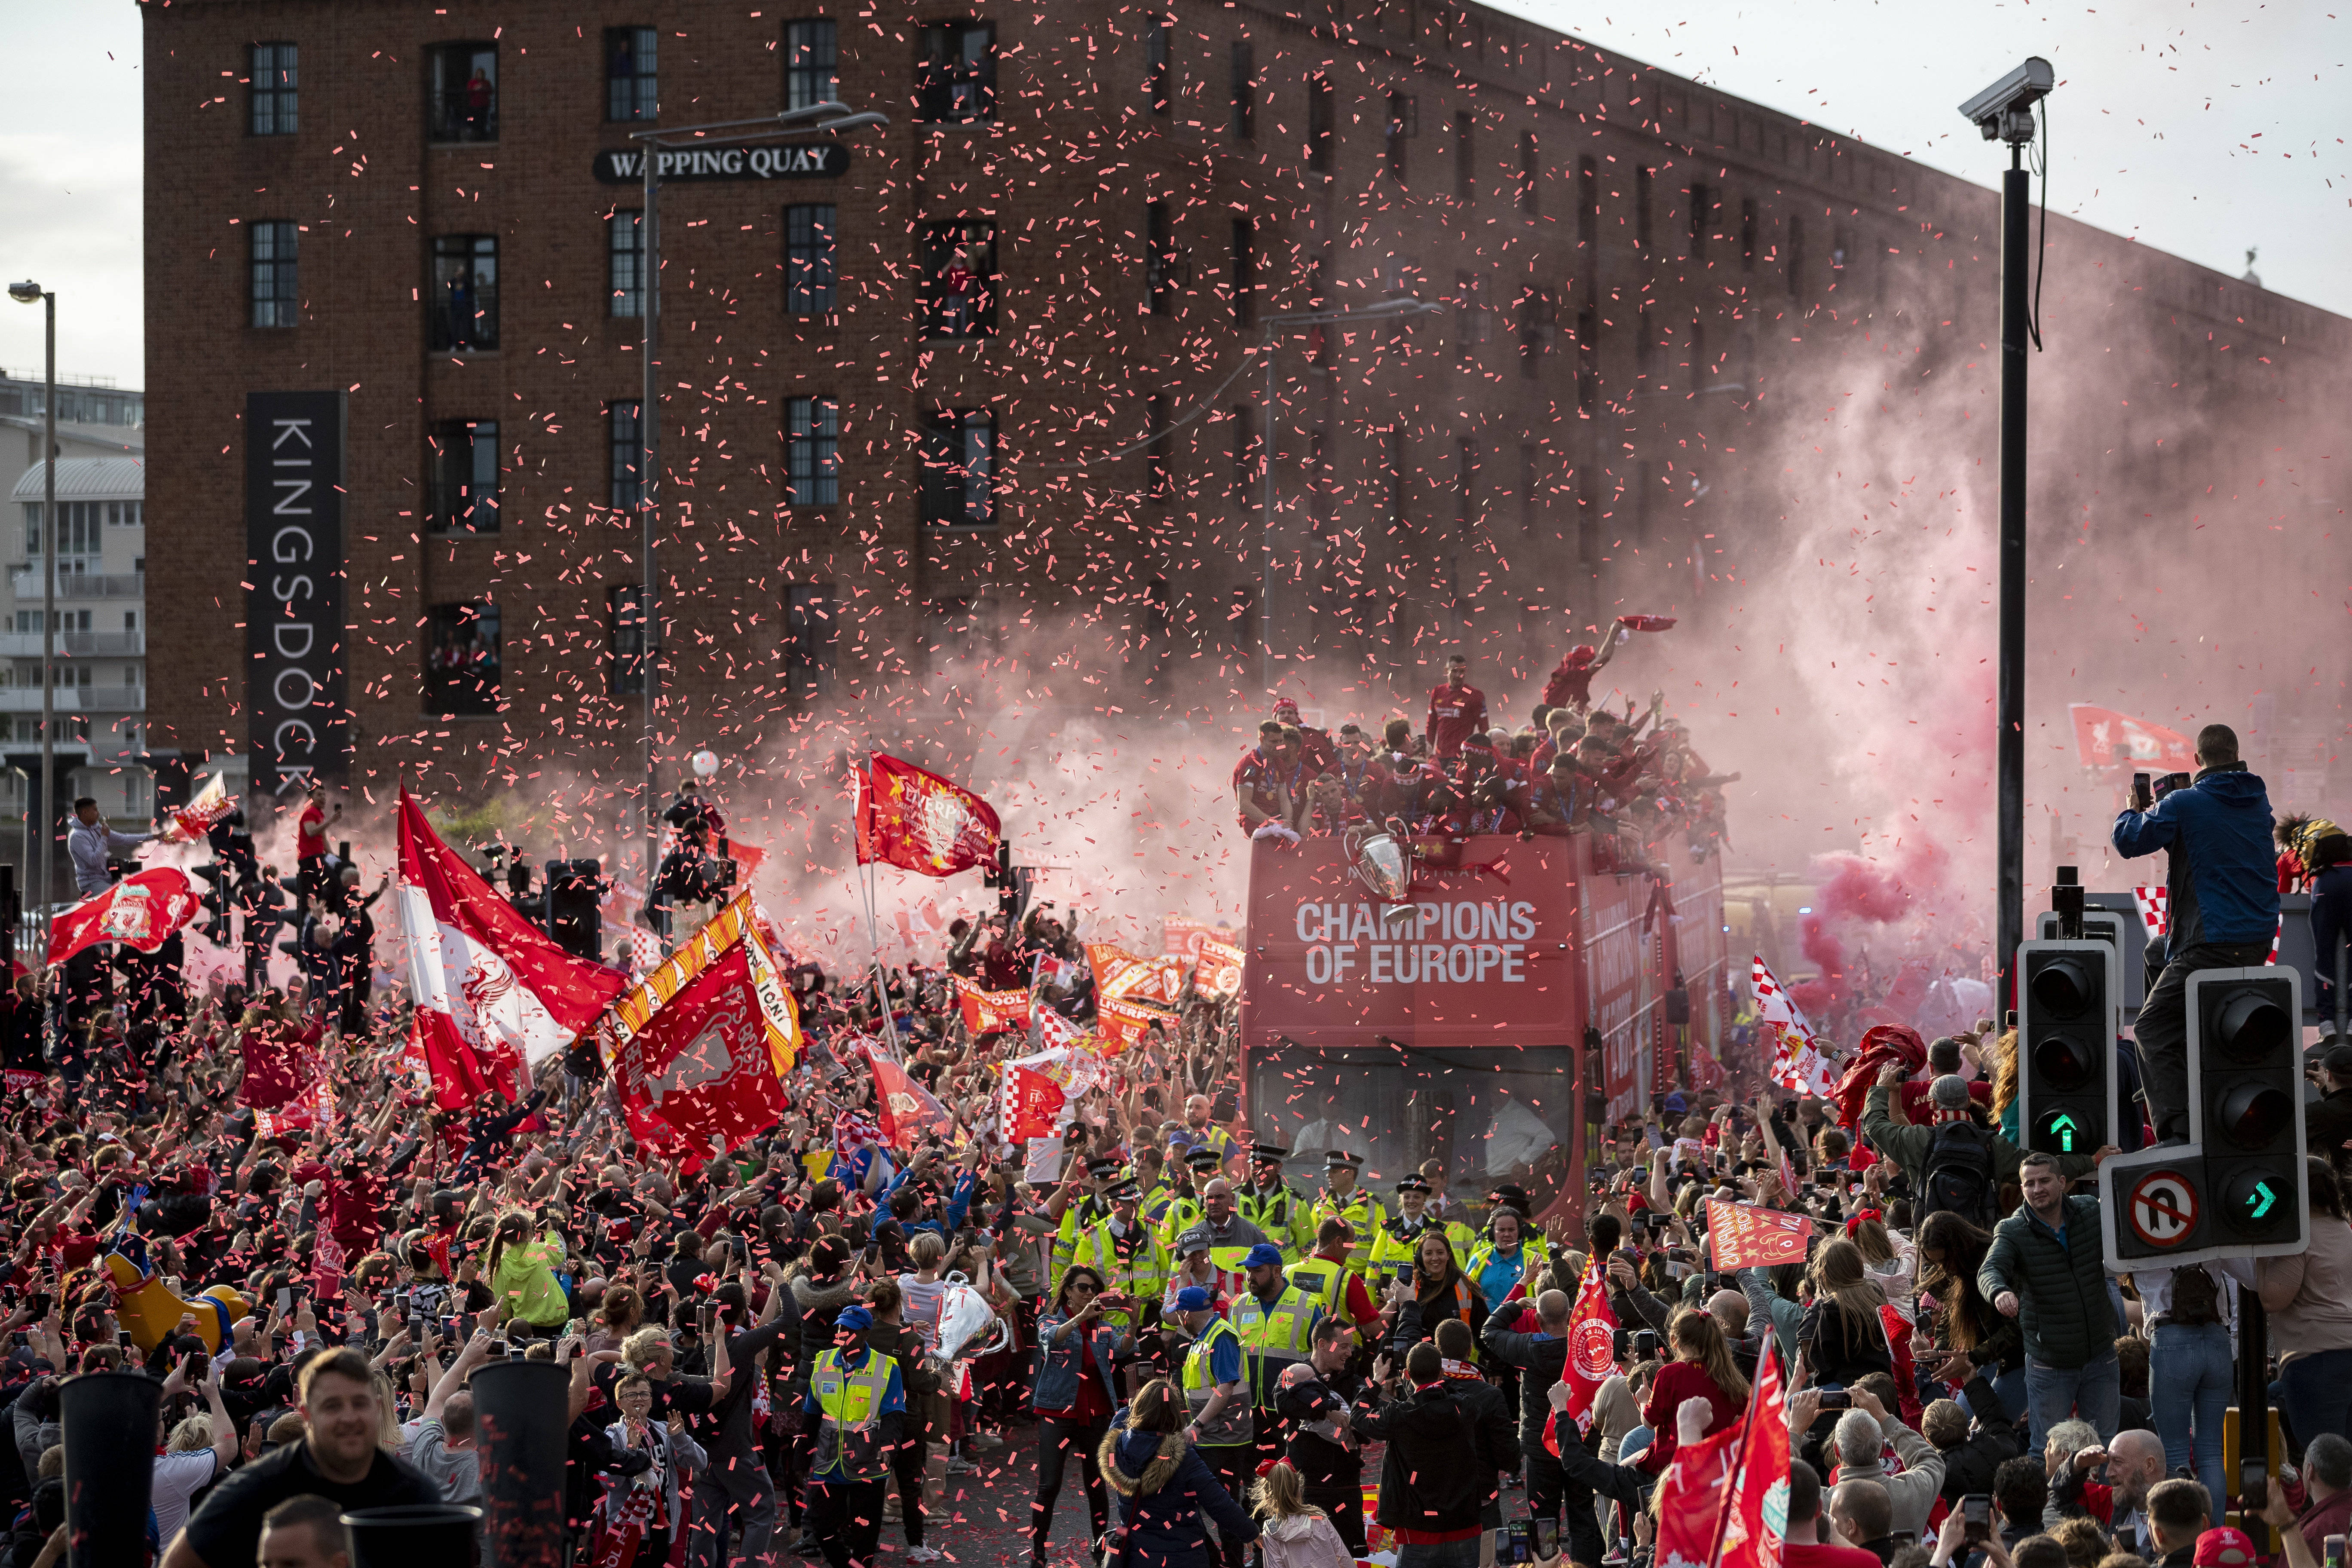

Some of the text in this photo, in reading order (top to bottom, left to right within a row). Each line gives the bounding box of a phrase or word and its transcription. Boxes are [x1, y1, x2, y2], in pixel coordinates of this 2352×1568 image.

[750, 147, 830, 178] QUAY
[273, 419, 315, 796] KINGS DOCK
[1295, 901, 1536, 942] CHAMPIONS
[1306, 943, 1526, 984] OF EUROPE
